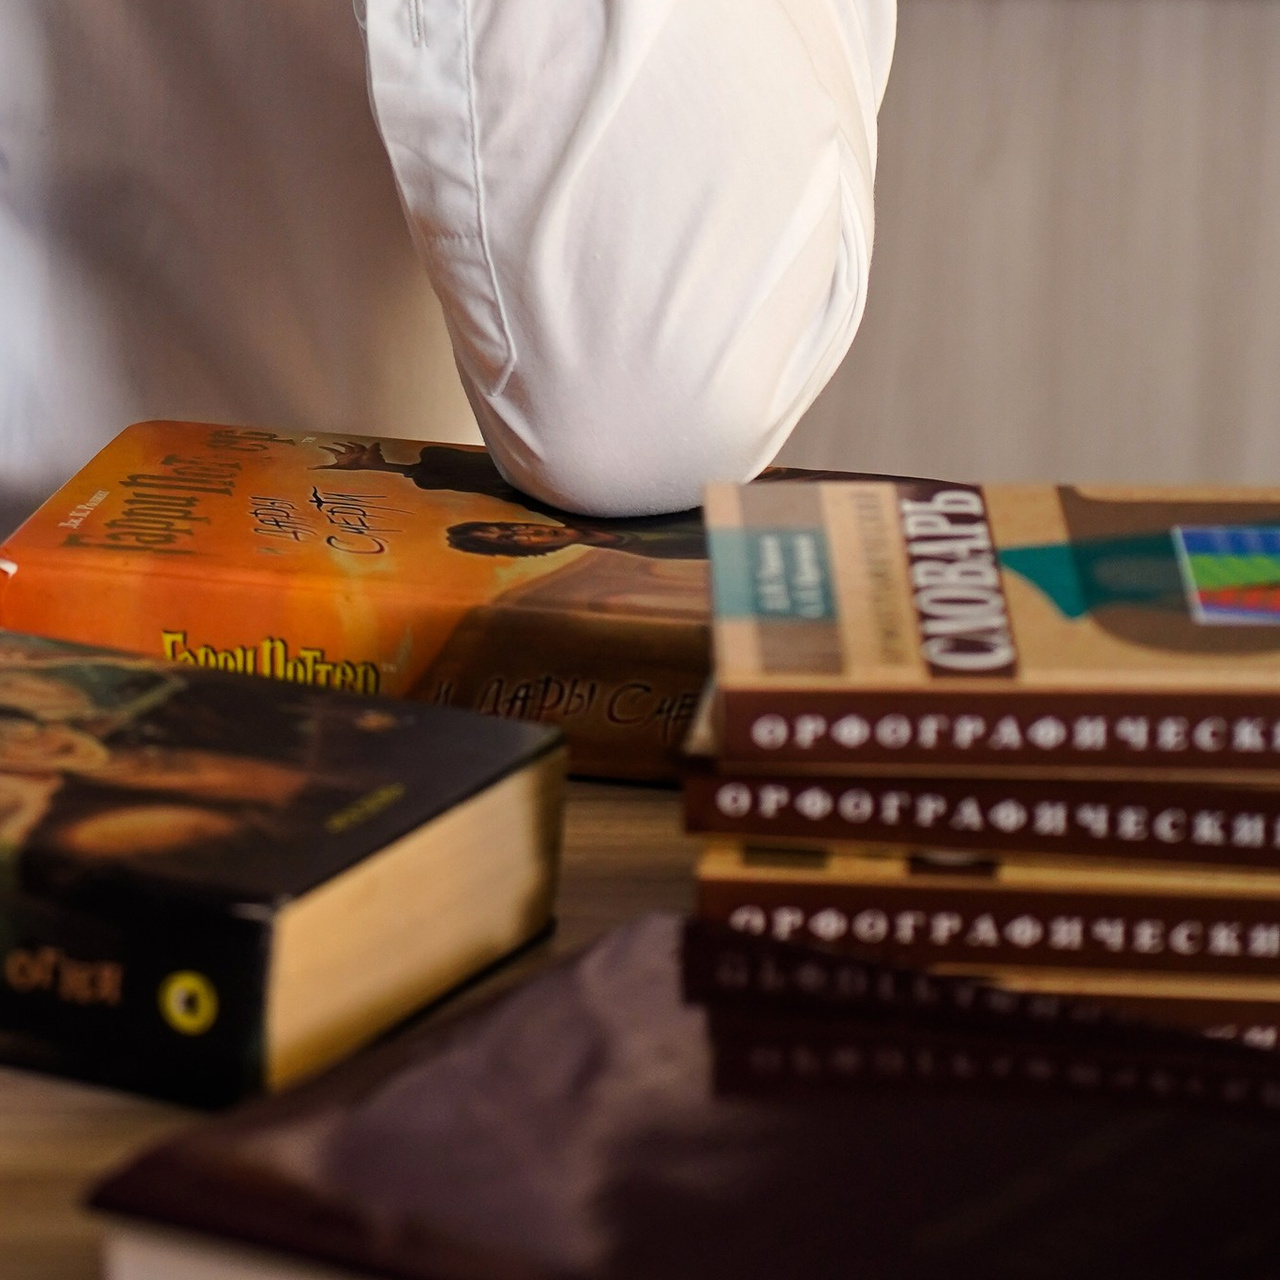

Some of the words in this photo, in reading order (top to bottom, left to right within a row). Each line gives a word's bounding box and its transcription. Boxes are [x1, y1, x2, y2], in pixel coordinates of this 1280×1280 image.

[901, 490, 1016, 670] СЛОВАРЬ
[751, 713, 1280, 753] ОРФОГРАФИЧЕСК
[716, 781, 1280, 851] ОРФОГРАФИЧЕСКИ
